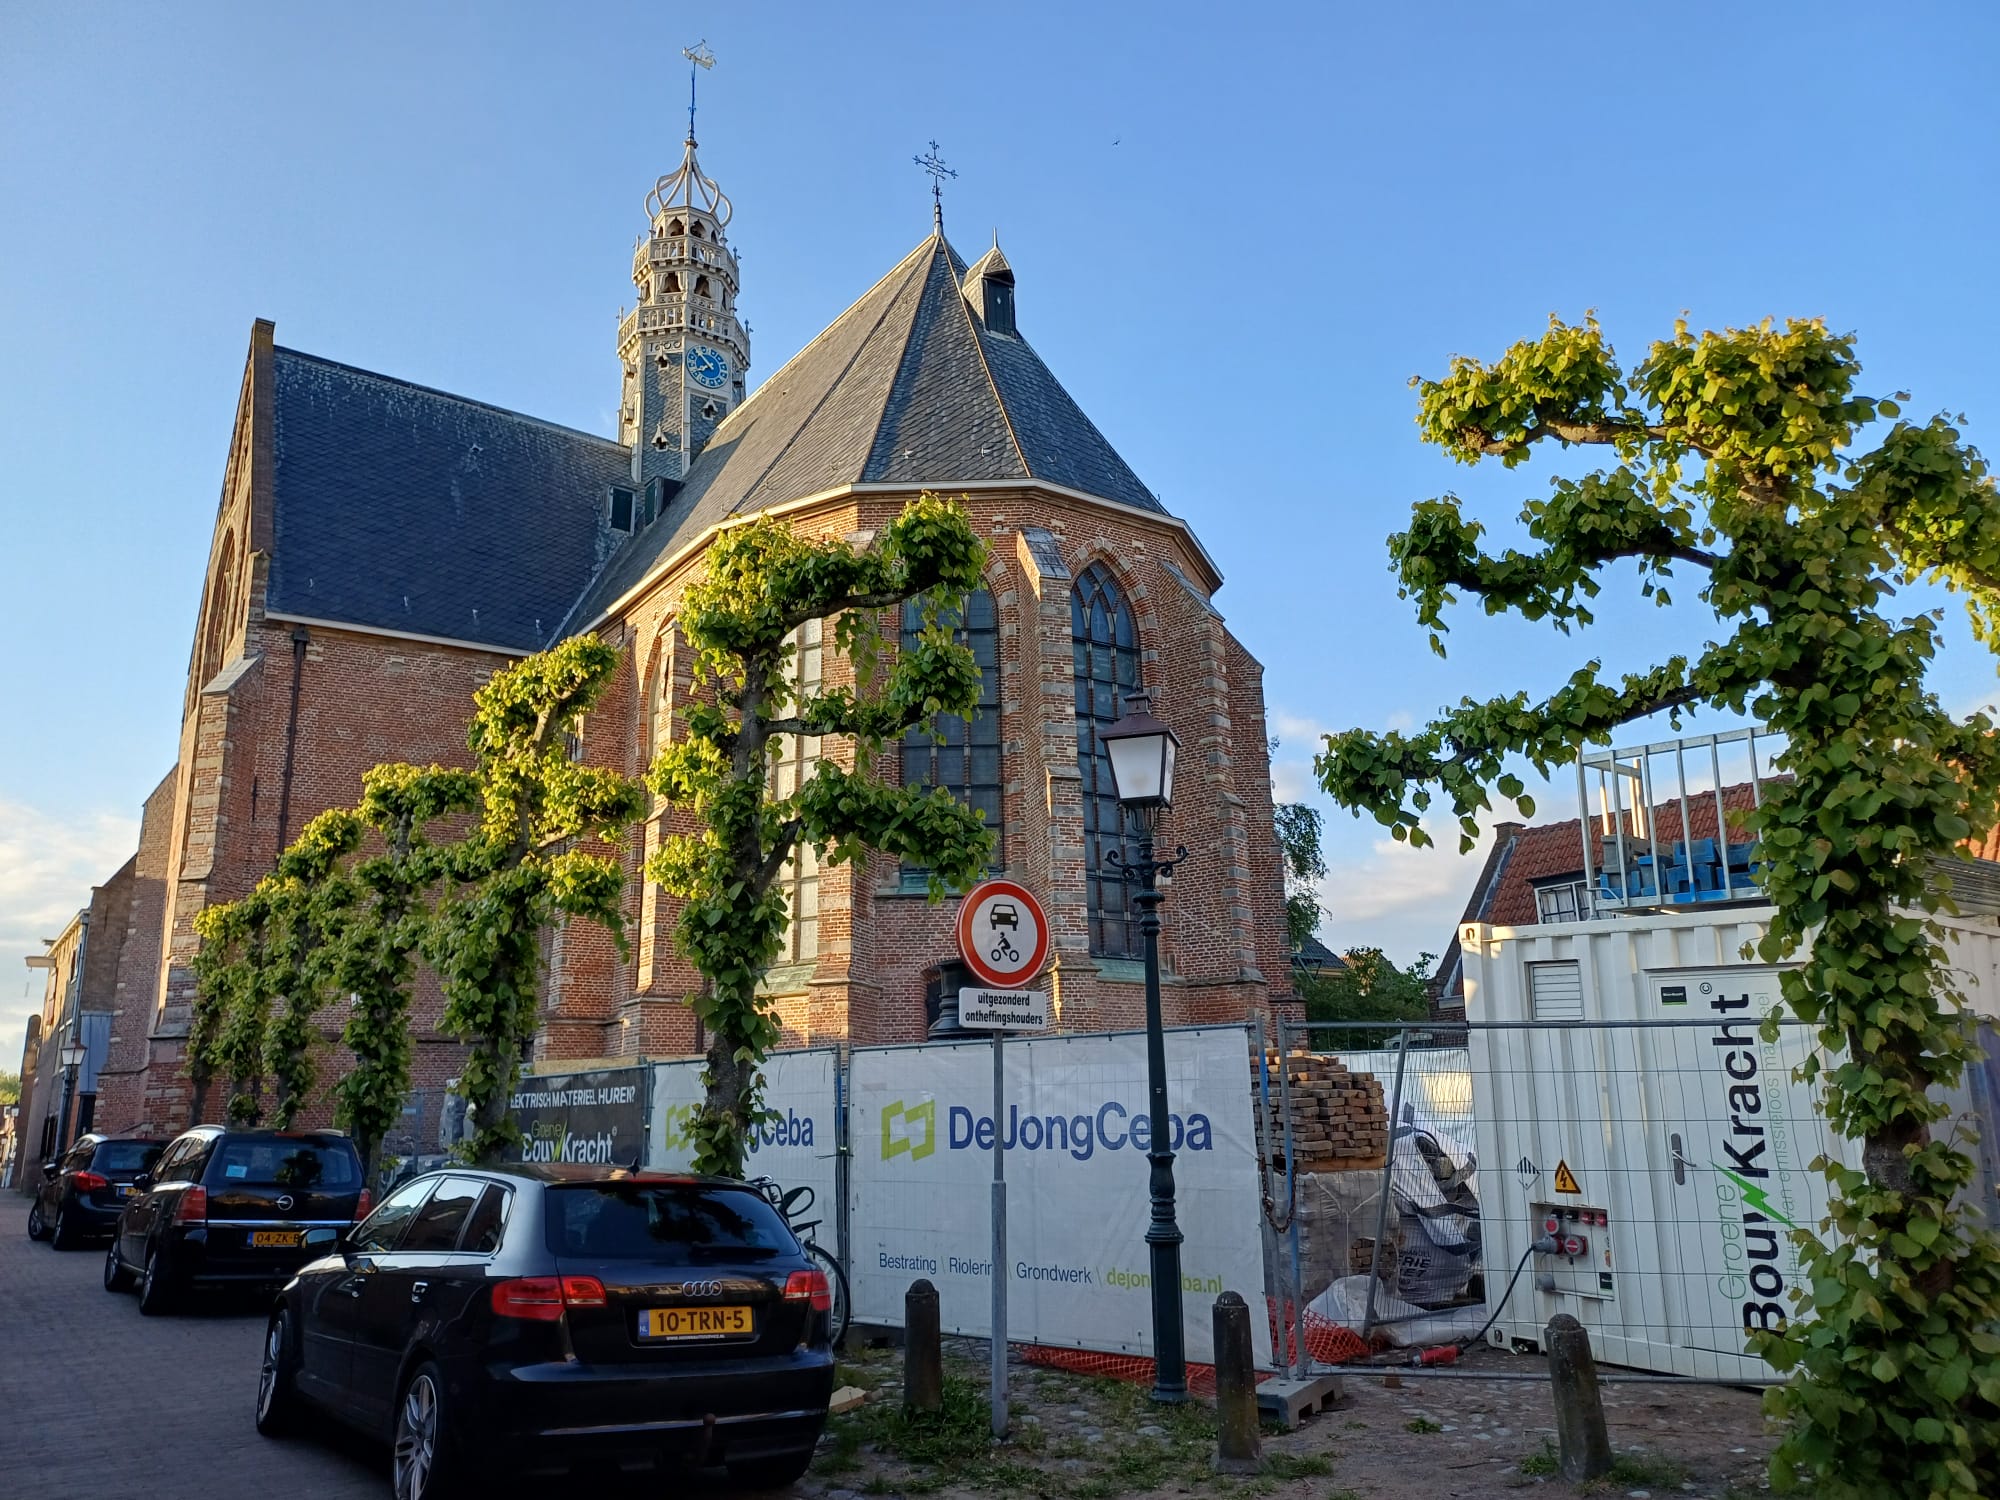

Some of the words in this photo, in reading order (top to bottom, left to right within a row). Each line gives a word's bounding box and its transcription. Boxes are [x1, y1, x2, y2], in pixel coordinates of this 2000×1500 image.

[977, 992, 1030, 1007] uitgezonderd
[965, 1010, 1043, 1026] ontheffingshouders
[1754, 992, 1777, 1070] maeel
[510, 1092, 551, 1109] LEKTRISCH
[552, 1089, 597, 1108] MATERIEEL
[1717, 1184, 1747, 1300] Groene
[879, 1252, 937, 1275] Bestrating
[949, 1257, 993, 1276] Riolerin
[1016, 1262, 1092, 1284] Grondwerk
[1107, 1267, 1222, 1294] dejonba.nl
[658, 1310, 744, 1332] 10-TRN-5
